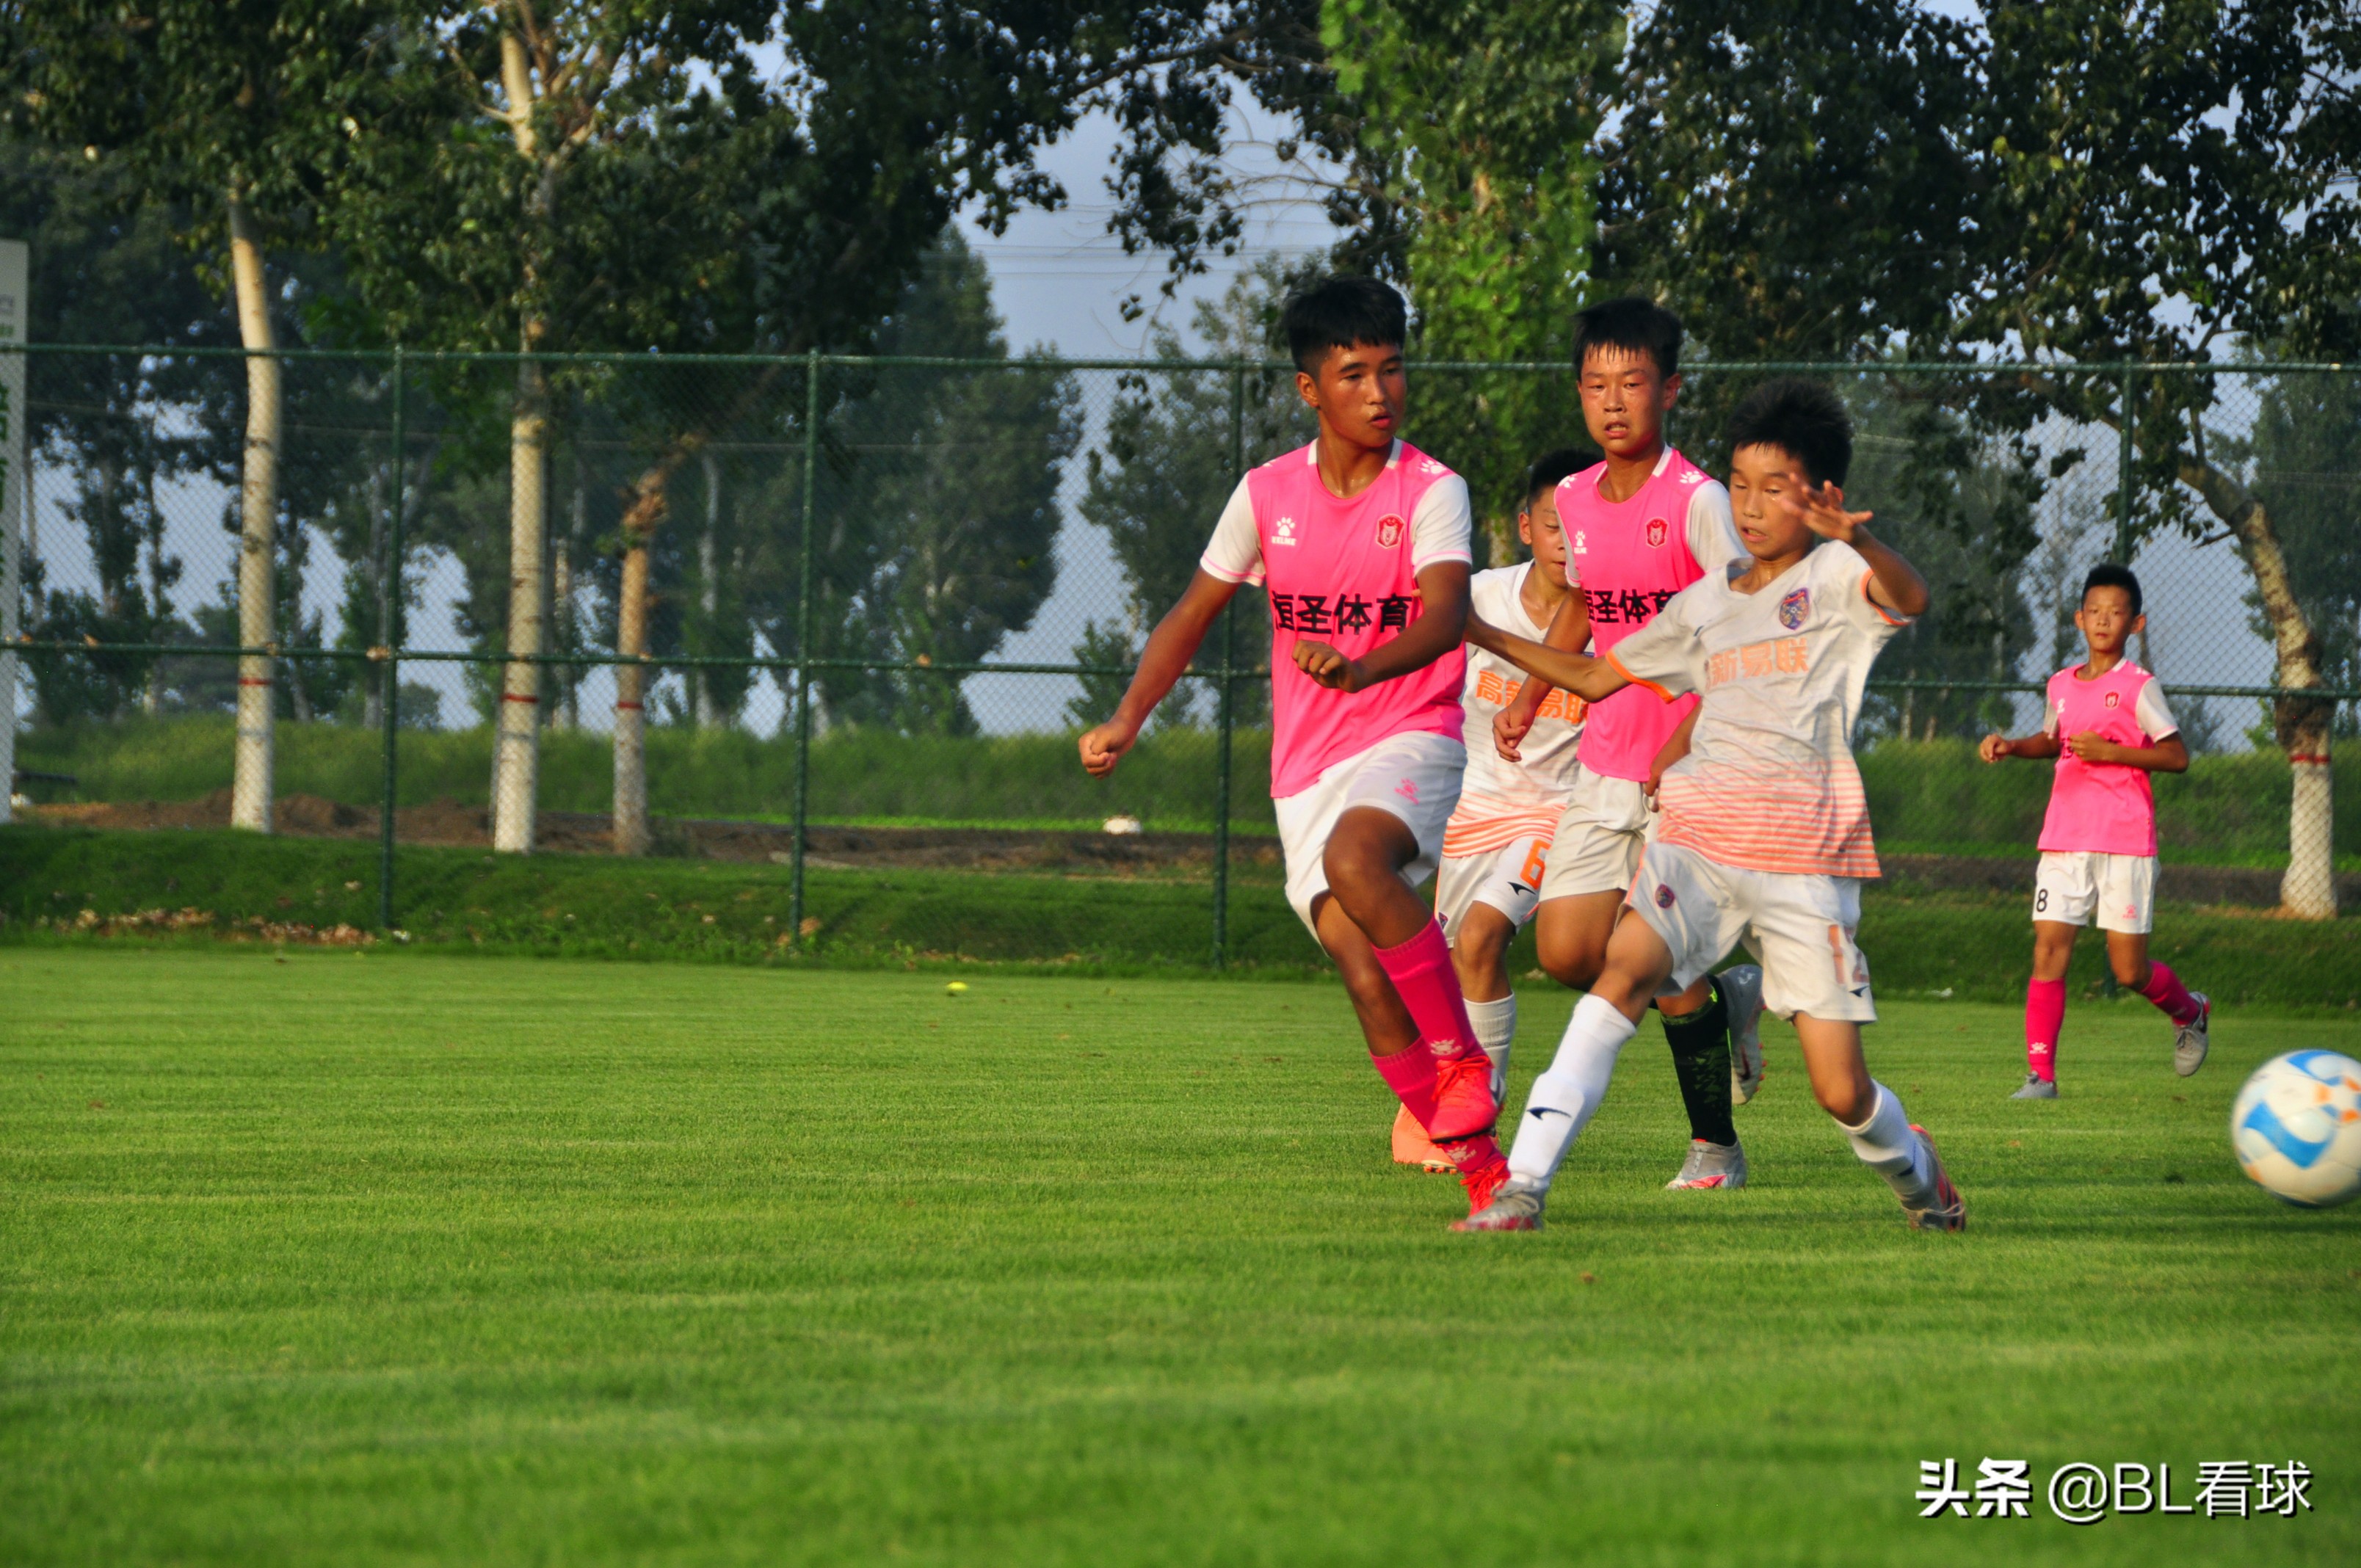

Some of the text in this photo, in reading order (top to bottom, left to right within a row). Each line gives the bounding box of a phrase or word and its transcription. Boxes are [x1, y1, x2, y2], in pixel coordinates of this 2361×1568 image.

[1704, 637, 1810, 693] 新易联
[1519, 839, 1552, 890] 6
[2036, 888, 2048, 912] 8
